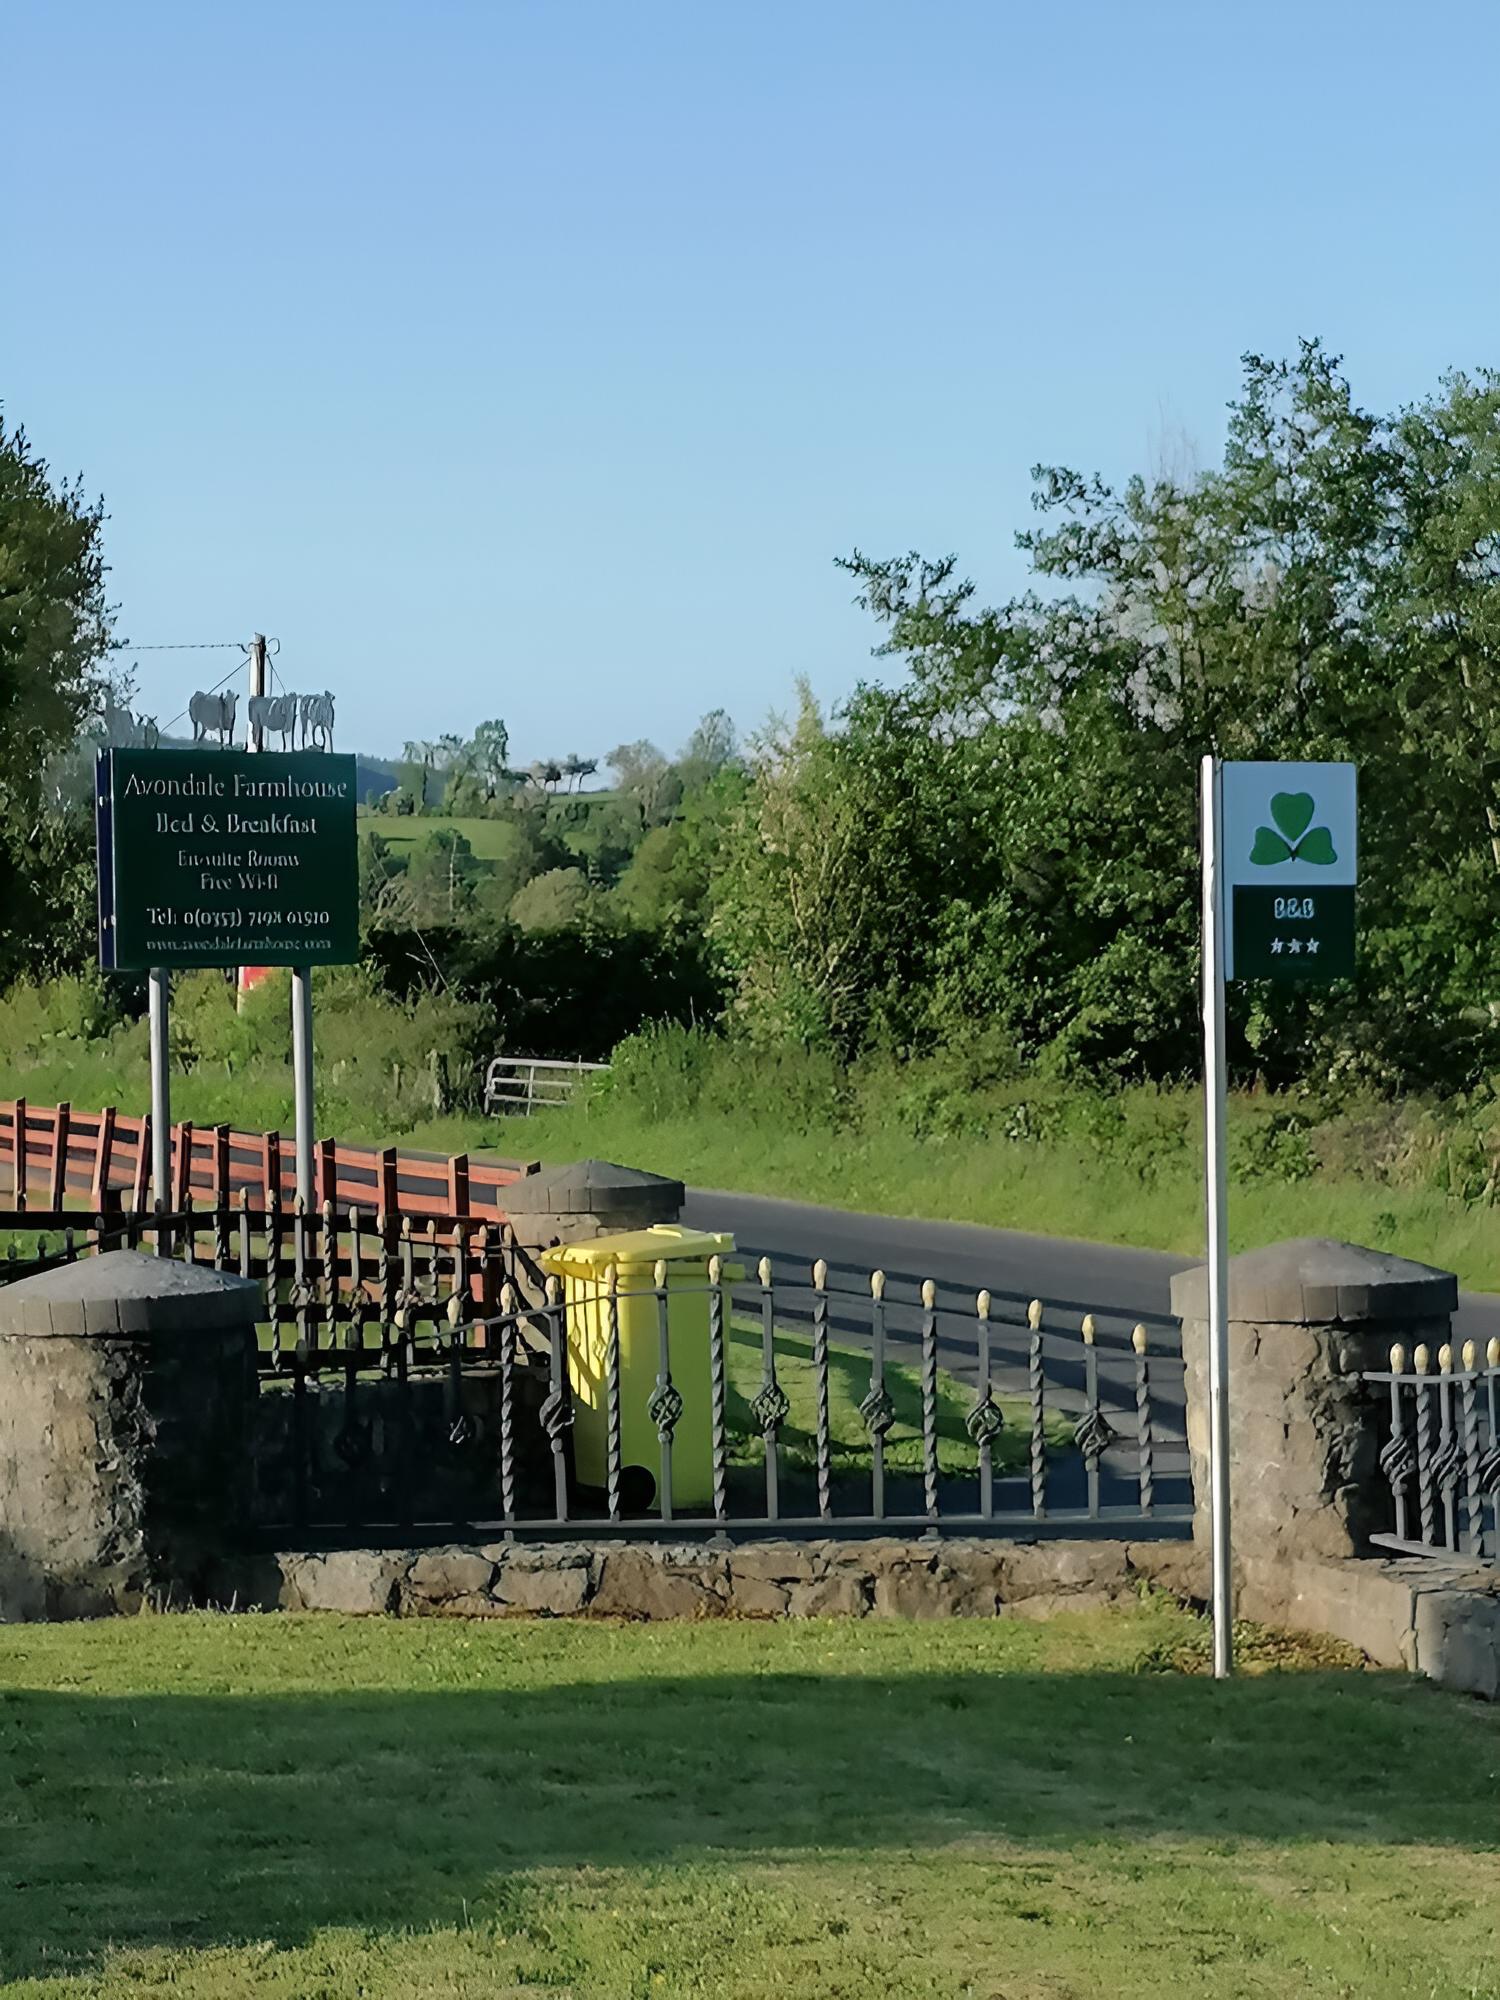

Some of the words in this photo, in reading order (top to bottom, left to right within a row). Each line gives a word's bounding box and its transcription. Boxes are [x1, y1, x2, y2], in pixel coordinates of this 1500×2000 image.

[123, 772, 225, 798] Avondale
[233, 773, 347, 798] Farmhouse
[156, 812, 194, 833] Bed
[200, 813, 220, 833] &
[227, 813, 317, 834] Breakfast
[248, 849, 300, 867] Rooms
[200, 872, 232, 890] Free
